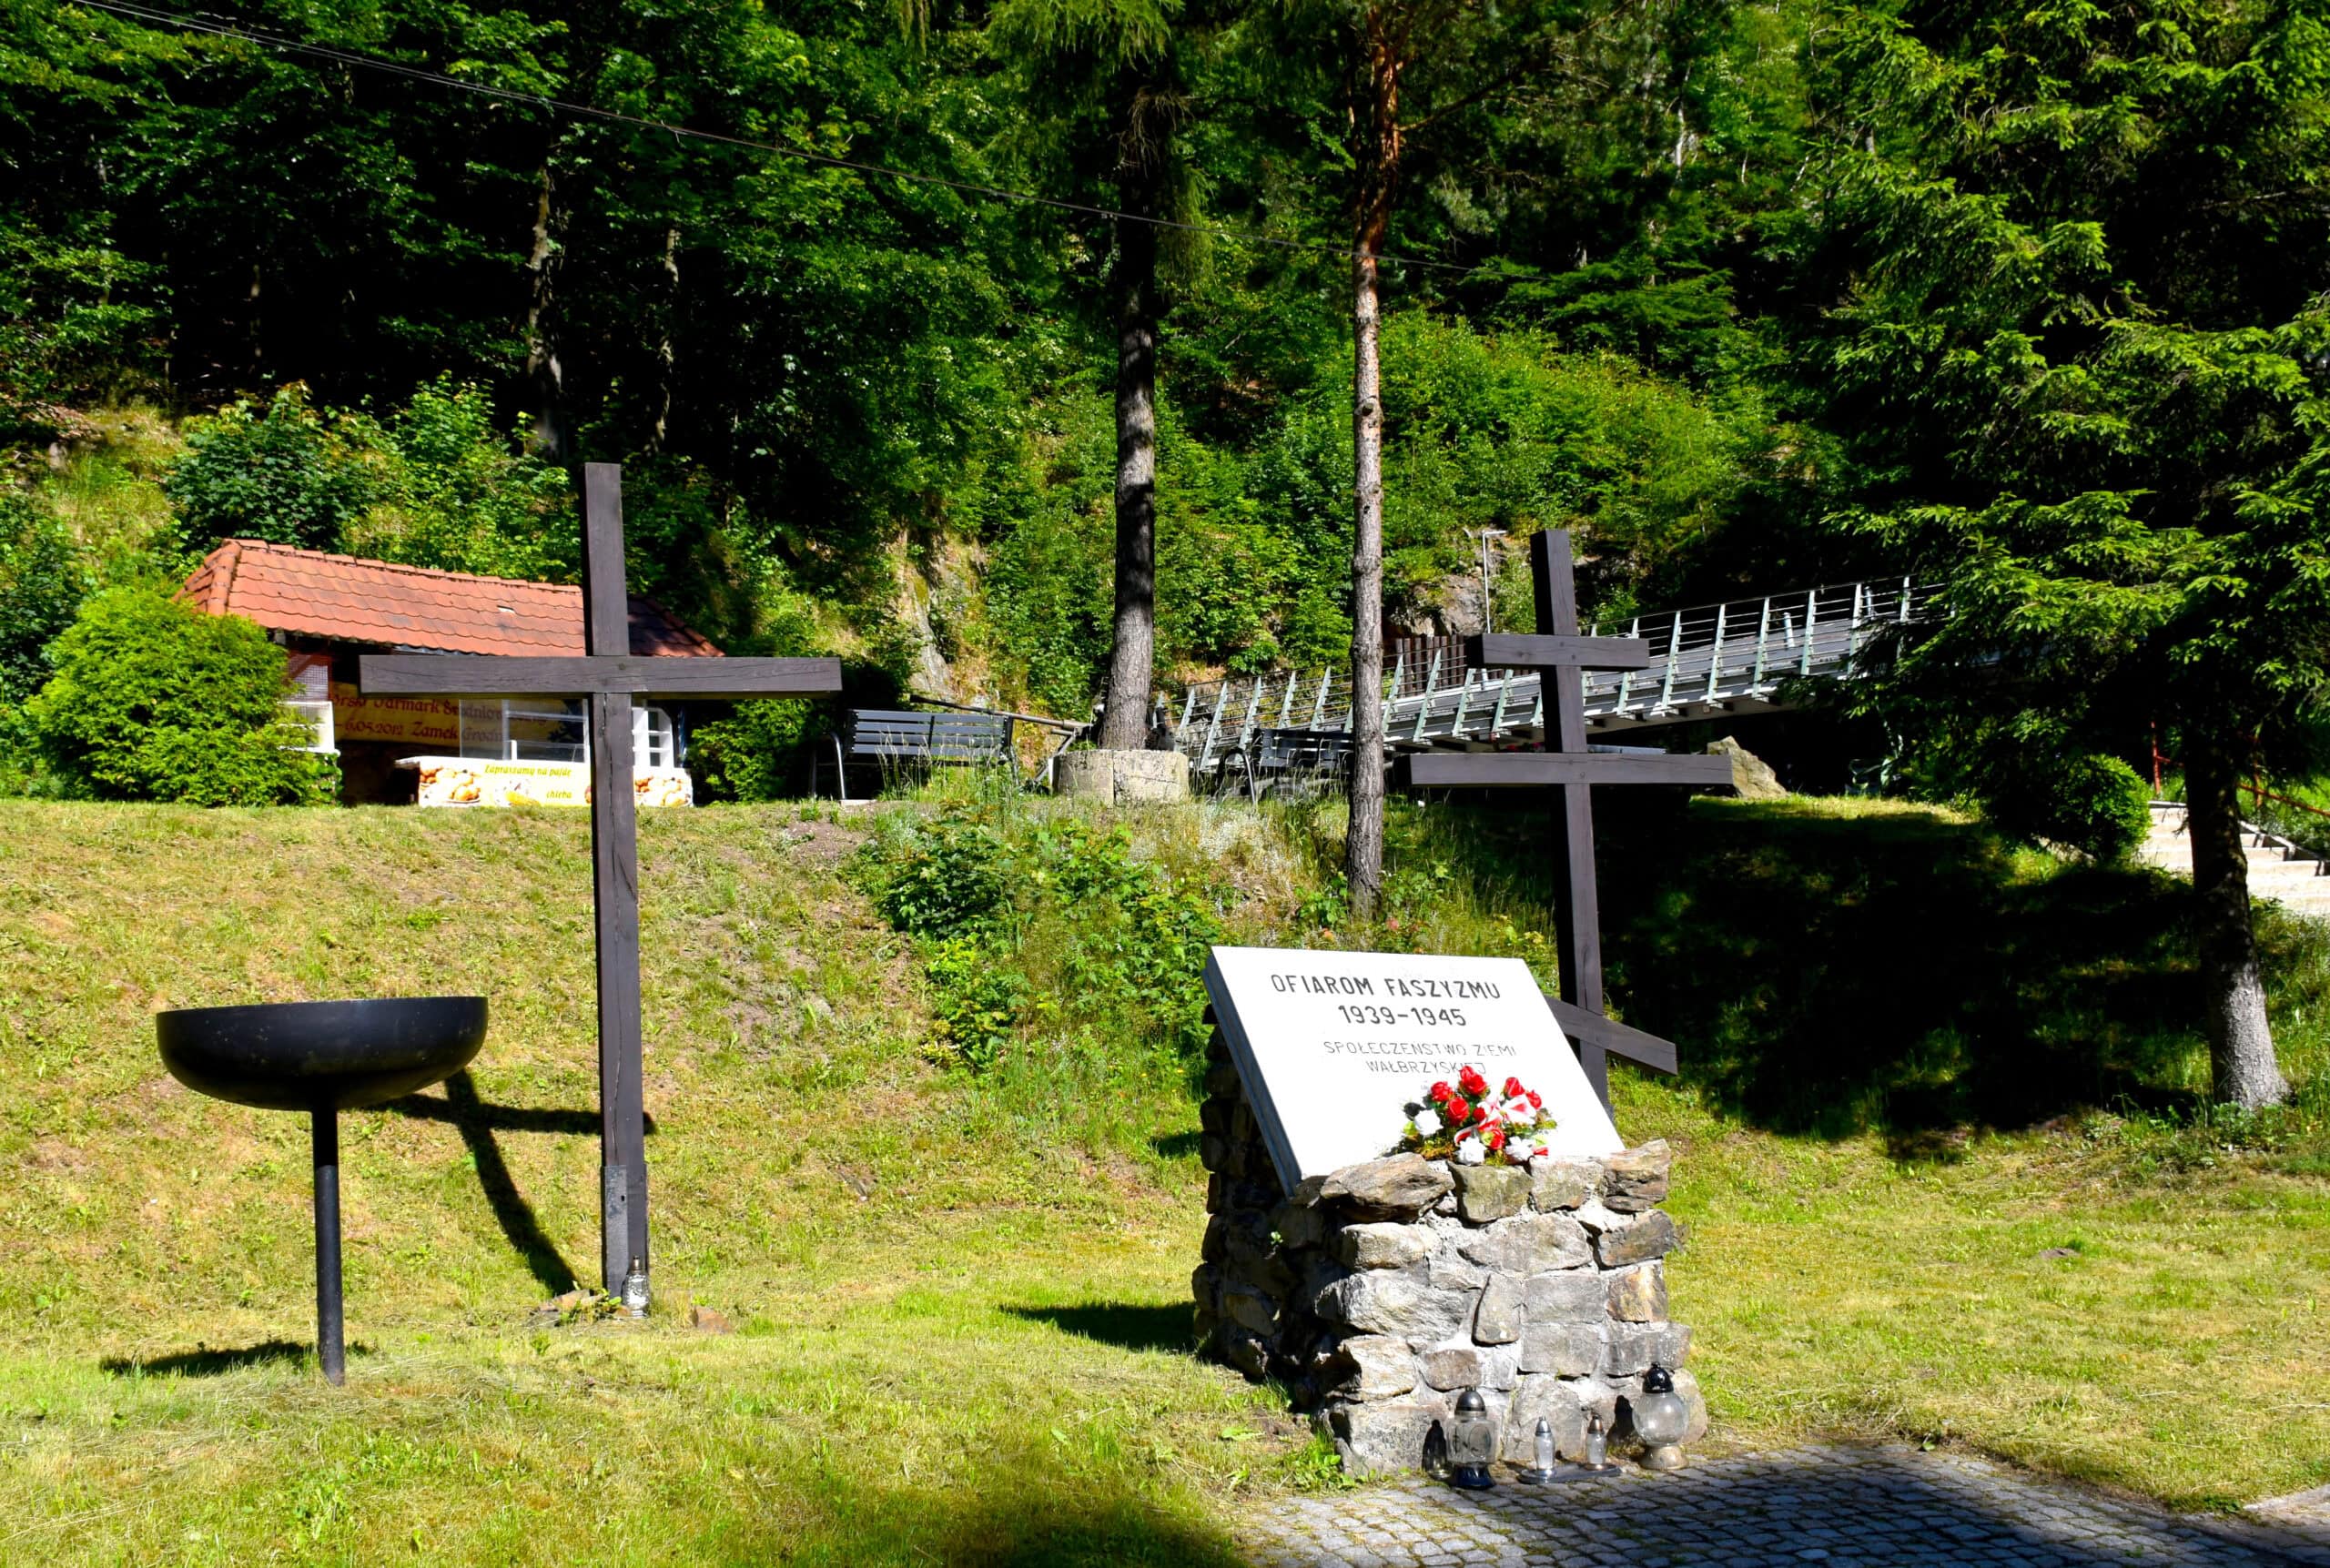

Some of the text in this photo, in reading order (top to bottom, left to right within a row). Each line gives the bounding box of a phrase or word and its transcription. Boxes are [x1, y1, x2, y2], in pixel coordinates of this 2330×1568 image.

[412, 722, 457, 739] Zamek
[1271, 974, 1501, 999] OFIAROM FASZYZMU
[1338, 1005, 1466, 1027] 1939-1945
[1473, 1044, 1517, 1057] ZIEMI
[1365, 1059, 1486, 1075] WAŁBRZYSKJ
